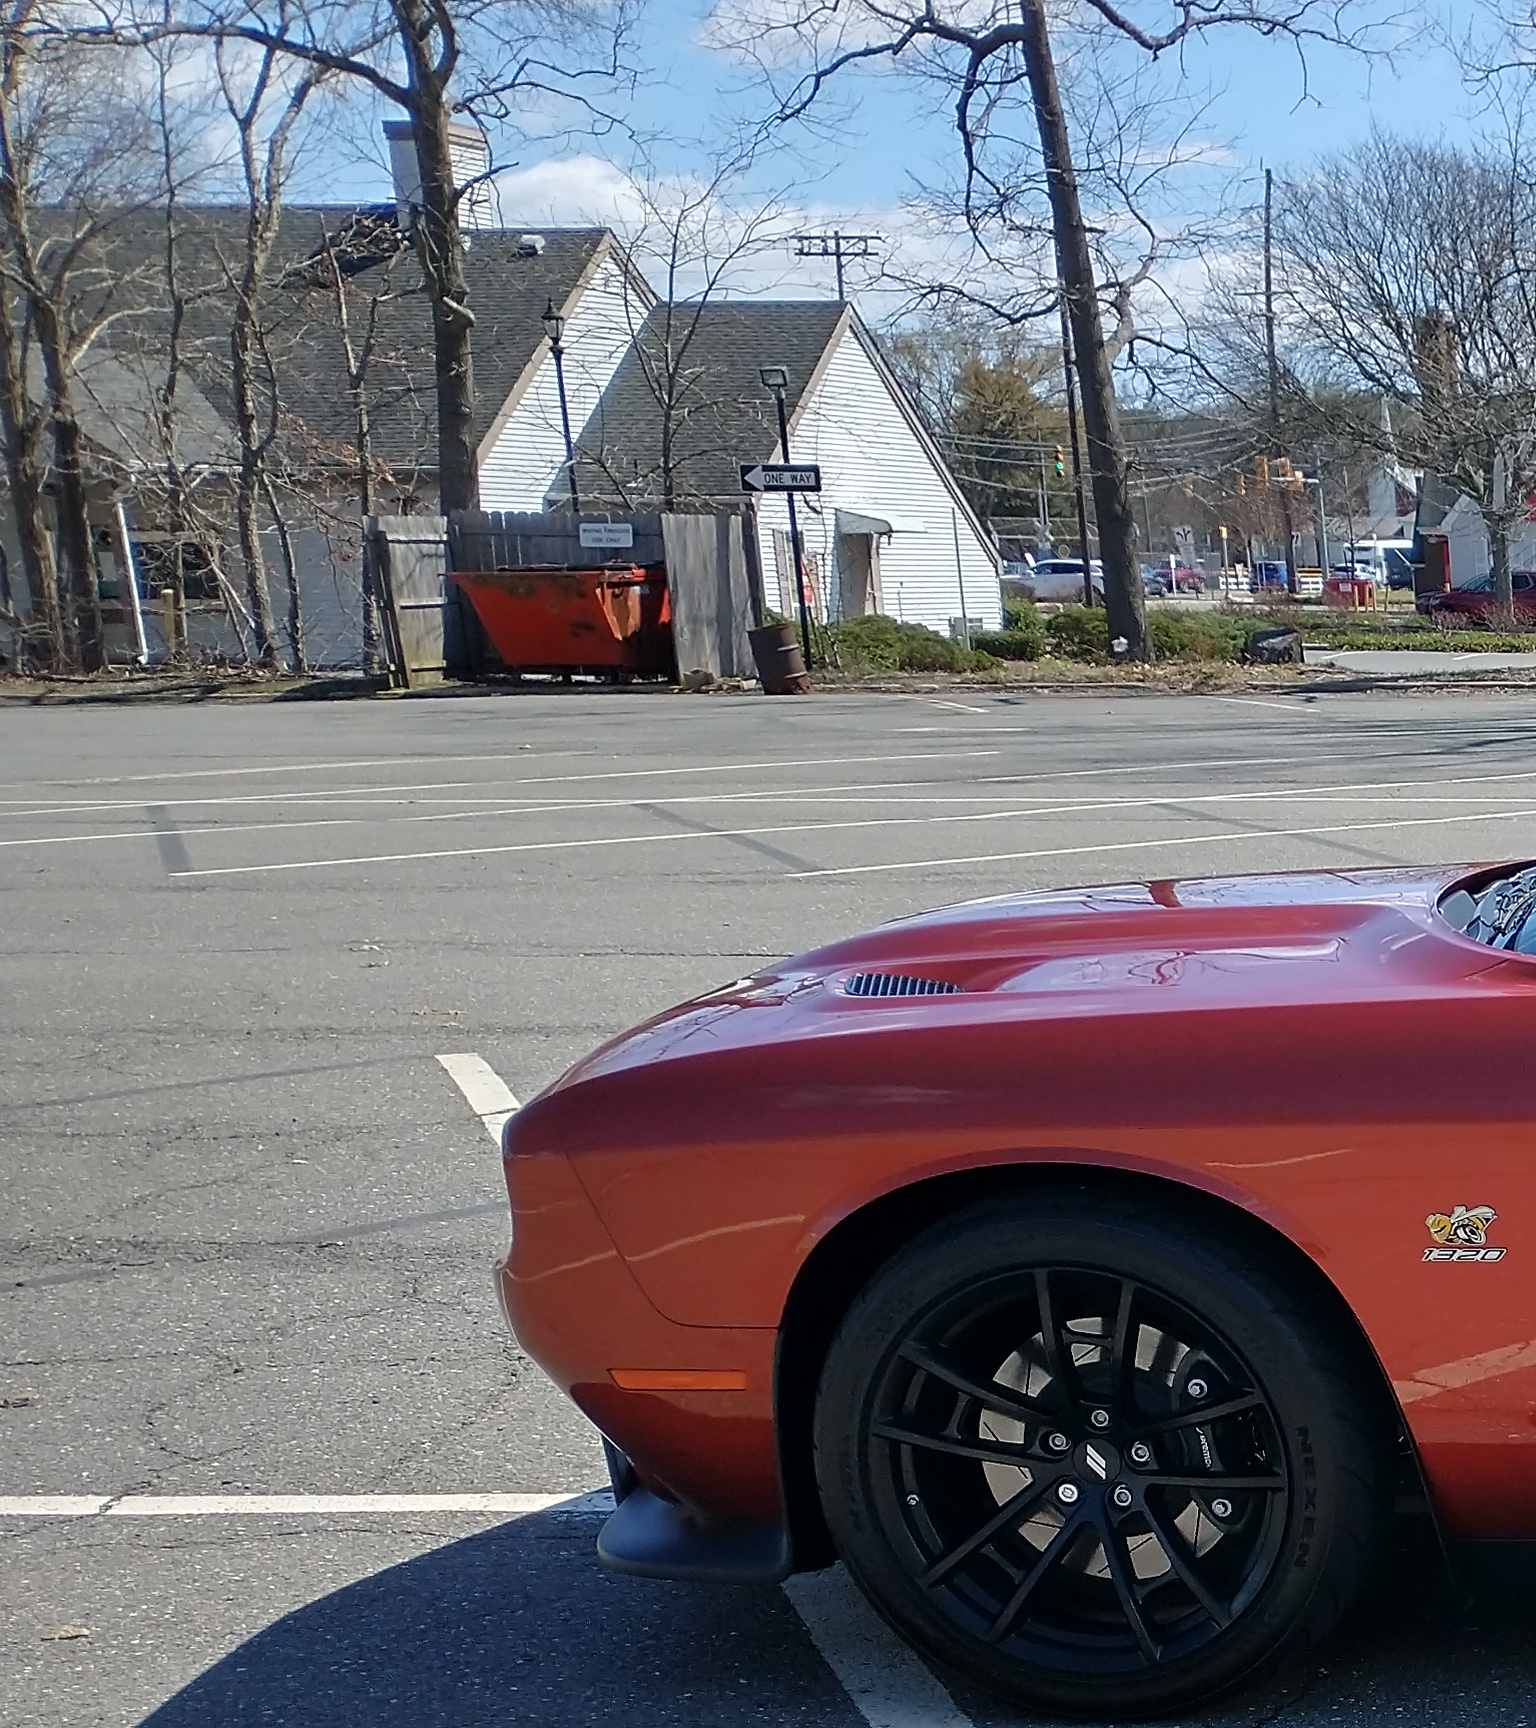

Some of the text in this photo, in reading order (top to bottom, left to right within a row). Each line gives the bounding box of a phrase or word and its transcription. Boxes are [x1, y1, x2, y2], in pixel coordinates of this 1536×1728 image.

[764, 474, 811, 484] ONE WAY
[1421, 1247, 1508, 1262] 1320
[1293, 1427, 1317, 1569] NEXEN
